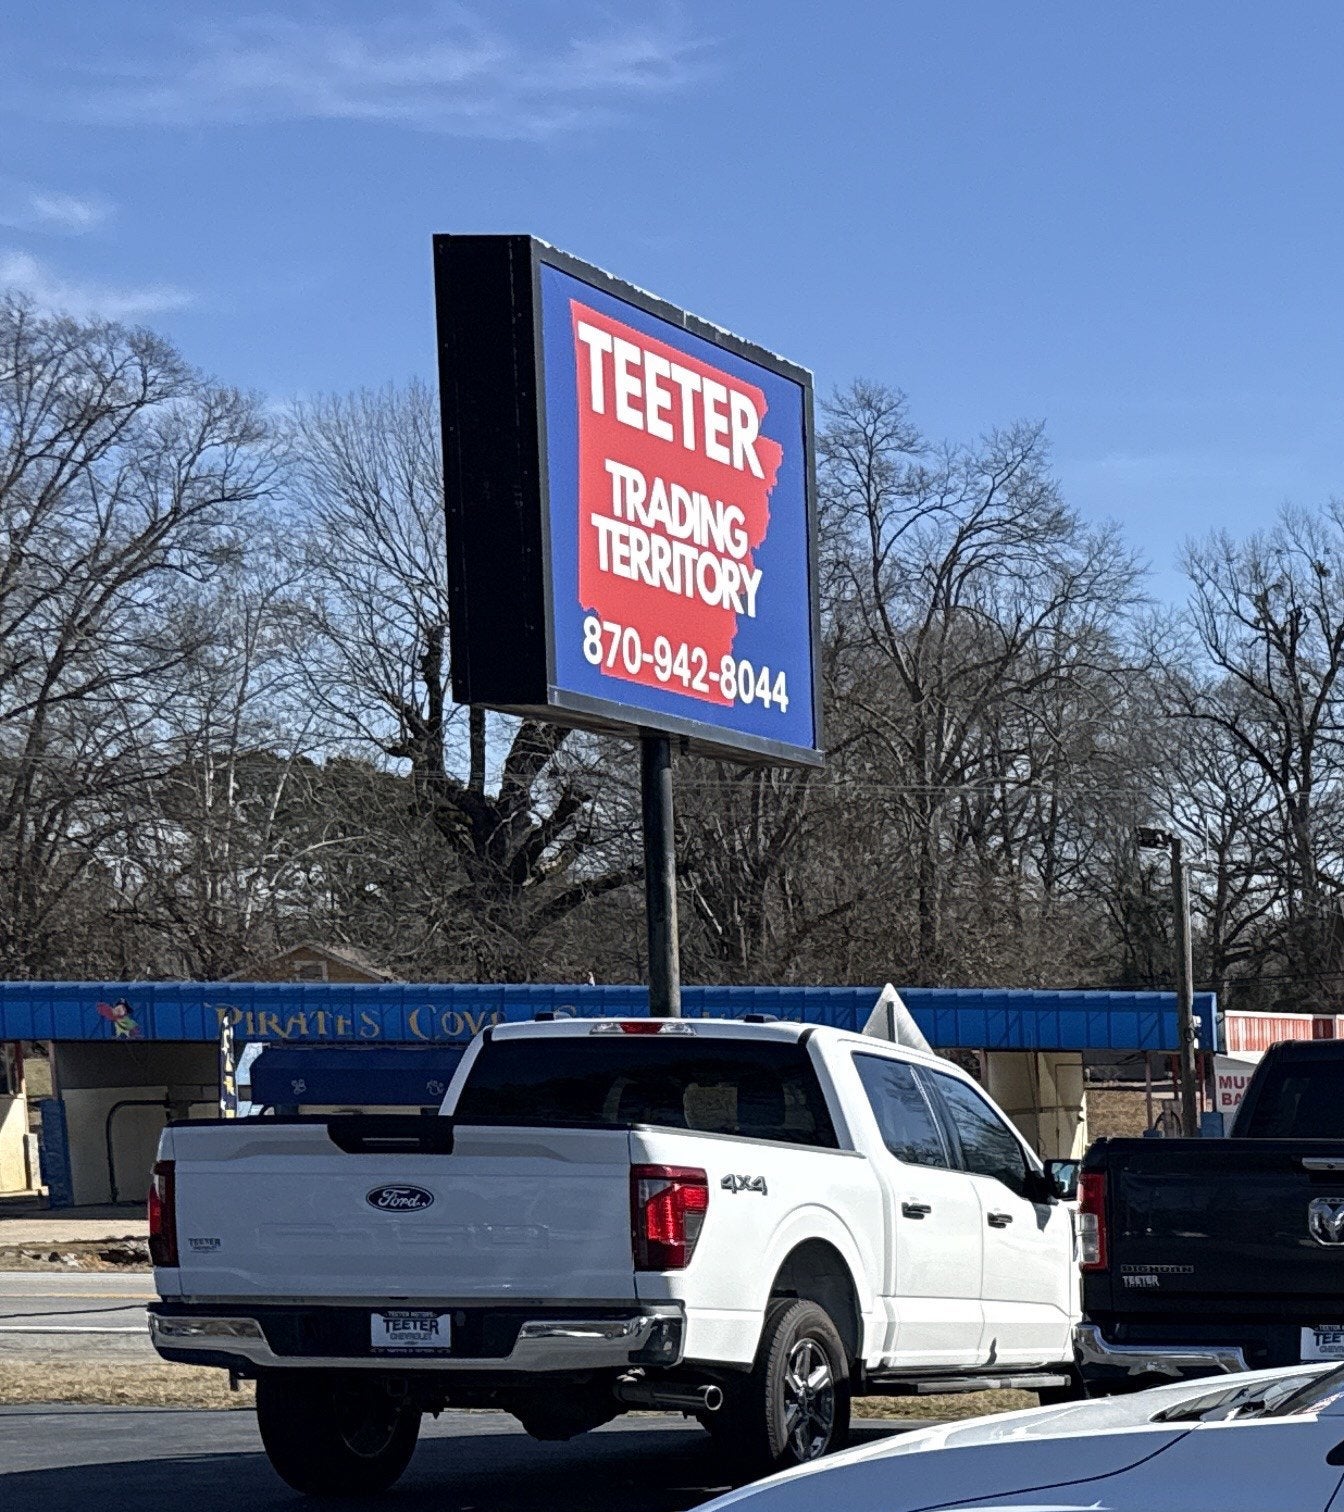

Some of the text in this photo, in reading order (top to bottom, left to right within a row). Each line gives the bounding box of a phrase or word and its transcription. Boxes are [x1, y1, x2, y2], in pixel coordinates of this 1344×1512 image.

[578, 321, 765, 479] TEETER
[605, 458, 749, 557] TRADING
[591, 513, 763, 618] TERRITORY
[582, 617, 790, 713] 870-942-8044
[378, 1189, 421, 1207] Ford
[383, 1319, 439, 1335] TEETER
